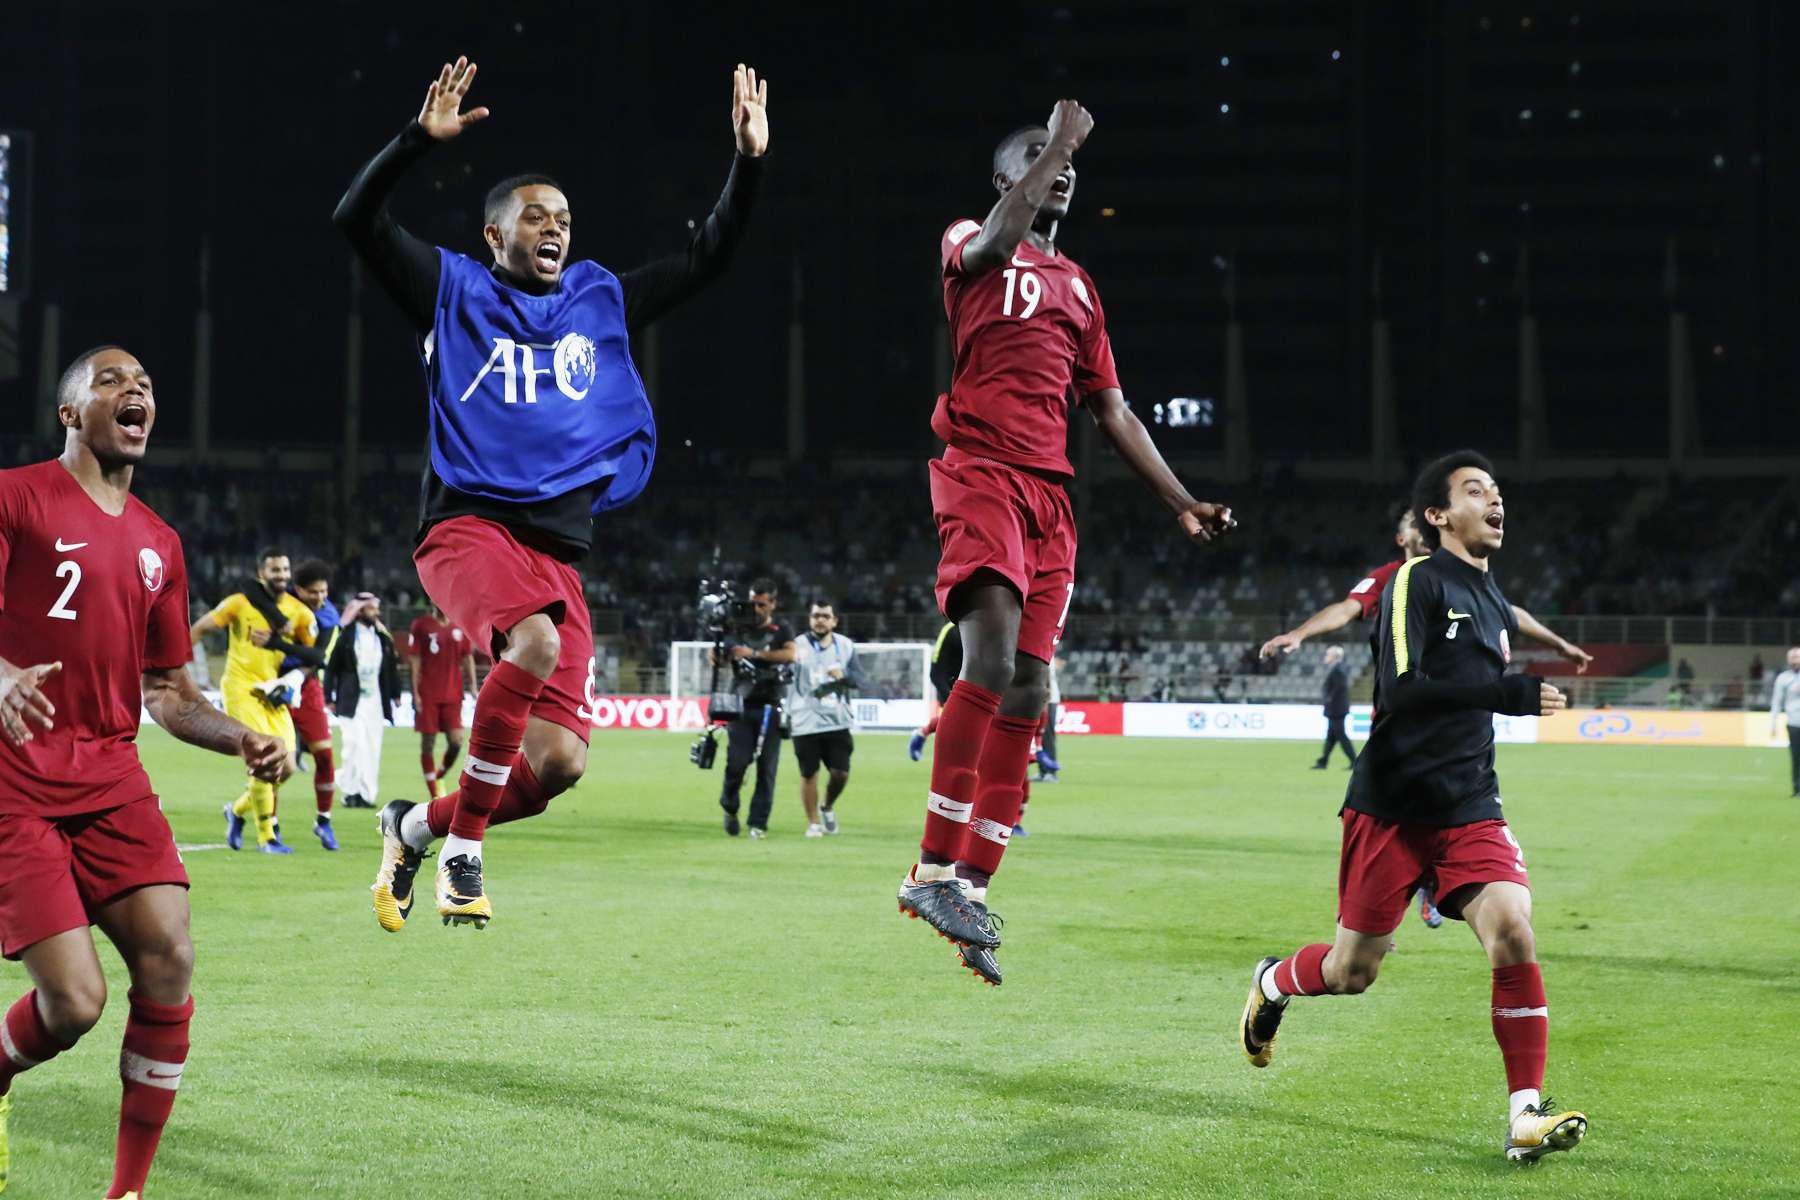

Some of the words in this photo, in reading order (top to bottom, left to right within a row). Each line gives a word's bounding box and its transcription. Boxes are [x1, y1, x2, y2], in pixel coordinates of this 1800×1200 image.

[1003, 269, 1041, 319] 19
[460, 332, 596, 403] AFC
[47, 560, 81, 620] 2
[591, 698, 705, 727] OYOTA
[1215, 711, 1265, 730] QNB
